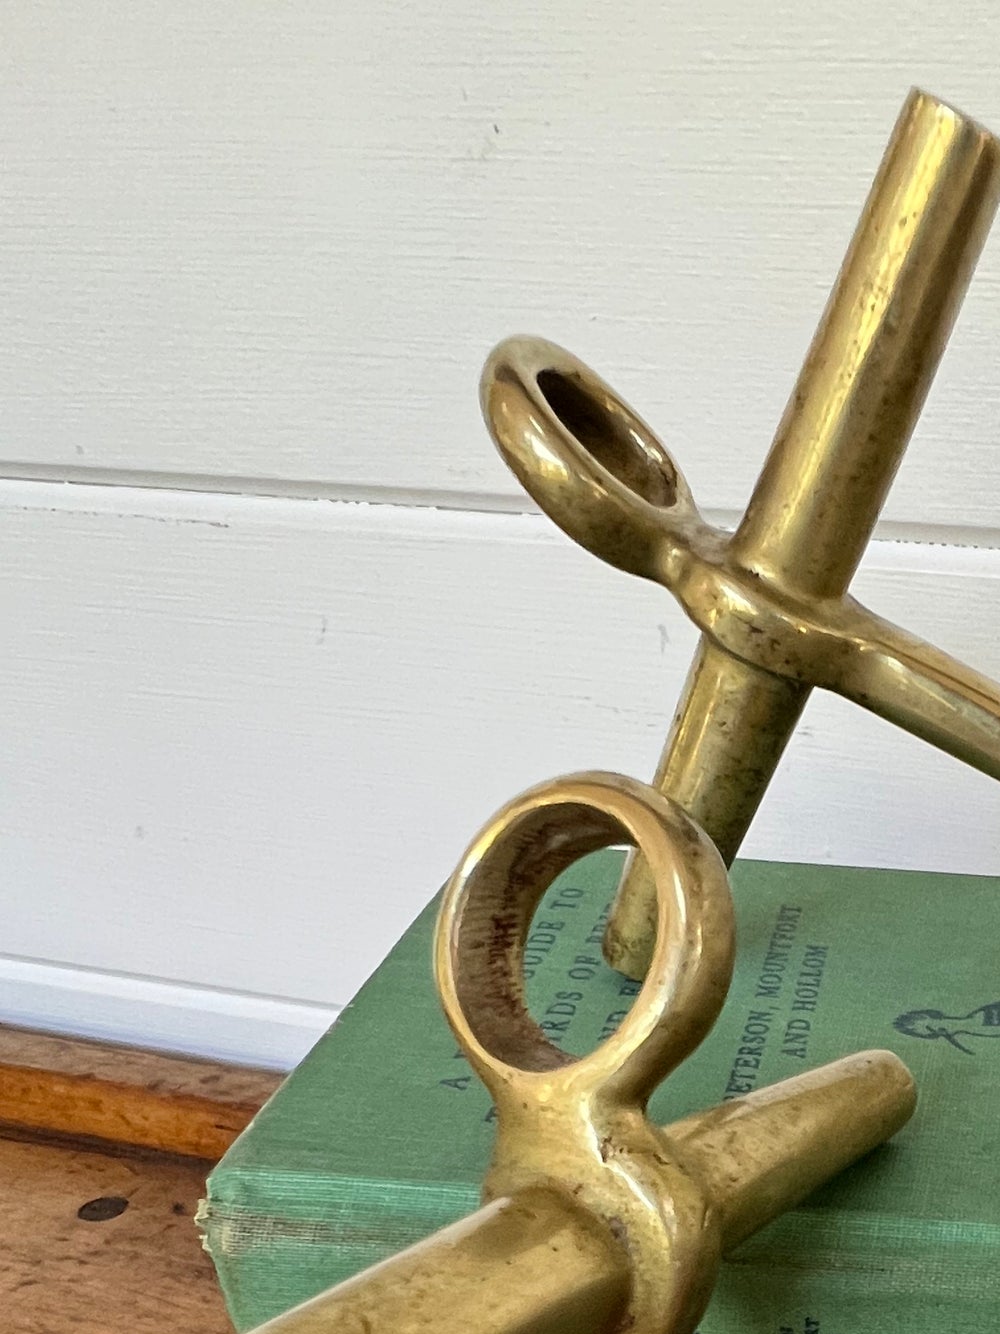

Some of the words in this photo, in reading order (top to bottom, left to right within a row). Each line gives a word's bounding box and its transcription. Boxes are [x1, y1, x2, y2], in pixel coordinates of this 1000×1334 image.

[439, 1076, 471, 1091] A
[551, 887, 584, 910] TO
[755, 903, 803, 999] MOUNTFORT
[791, 944, 830, 1012] HOLLOM
[780, 1018, 811, 1059] AND
